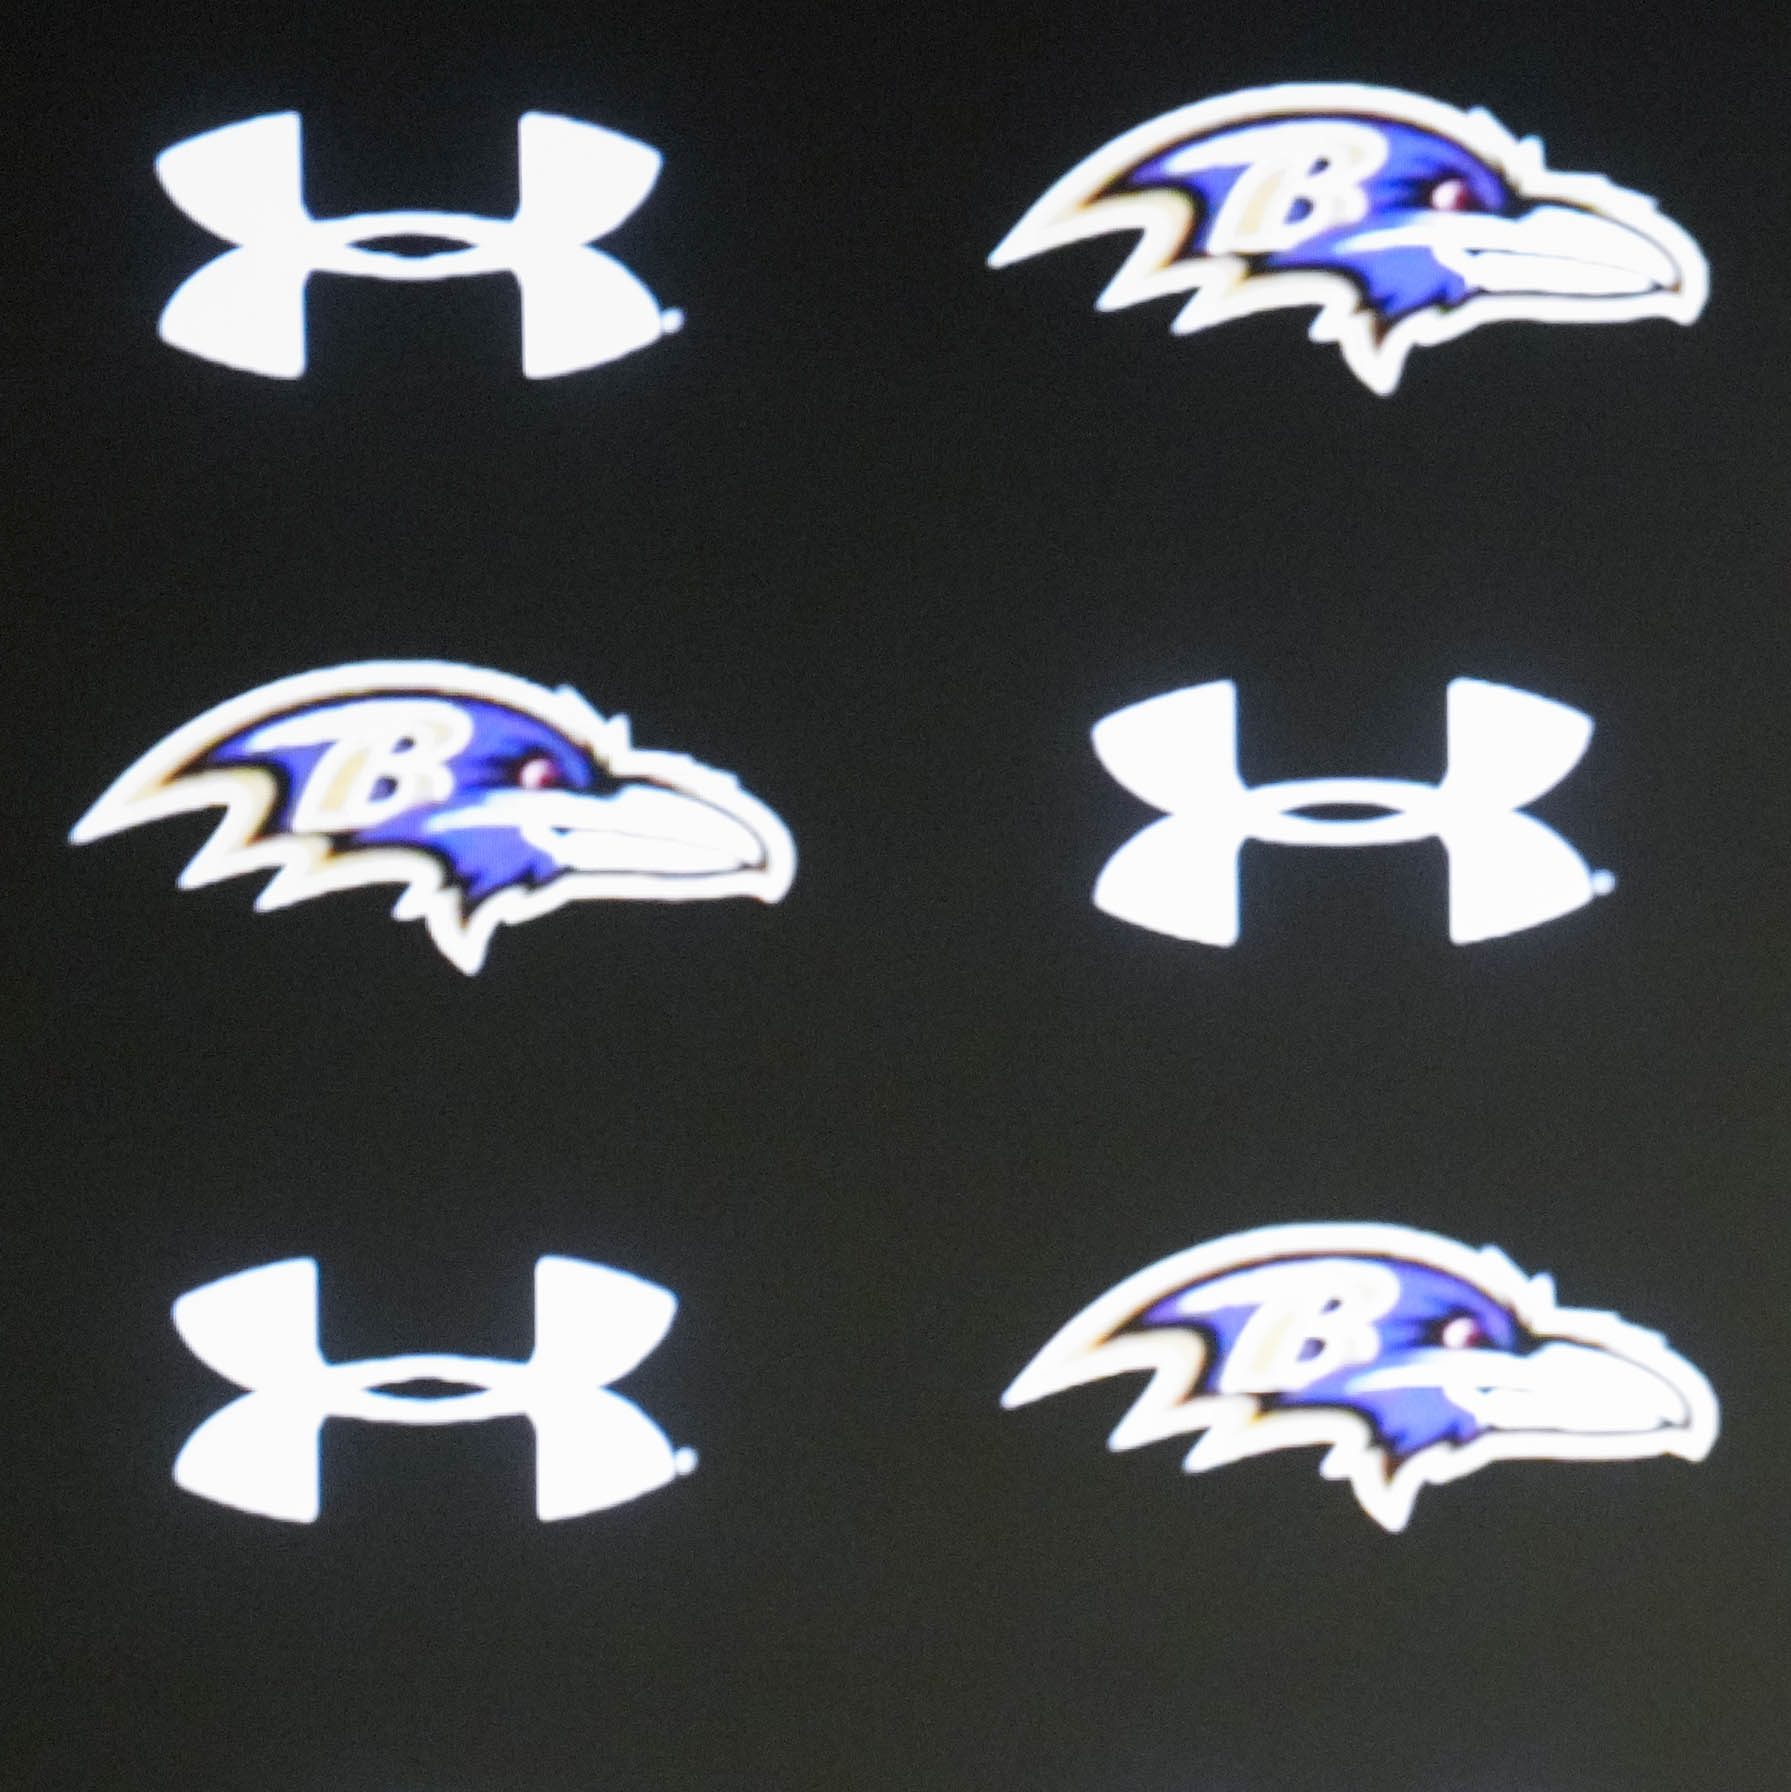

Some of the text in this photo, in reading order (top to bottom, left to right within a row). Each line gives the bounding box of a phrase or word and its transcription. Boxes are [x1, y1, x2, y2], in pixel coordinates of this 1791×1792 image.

[1162, 118, 1389, 255] B
[246, 696, 473, 833] B
[1174, 1257, 1401, 1394] B
